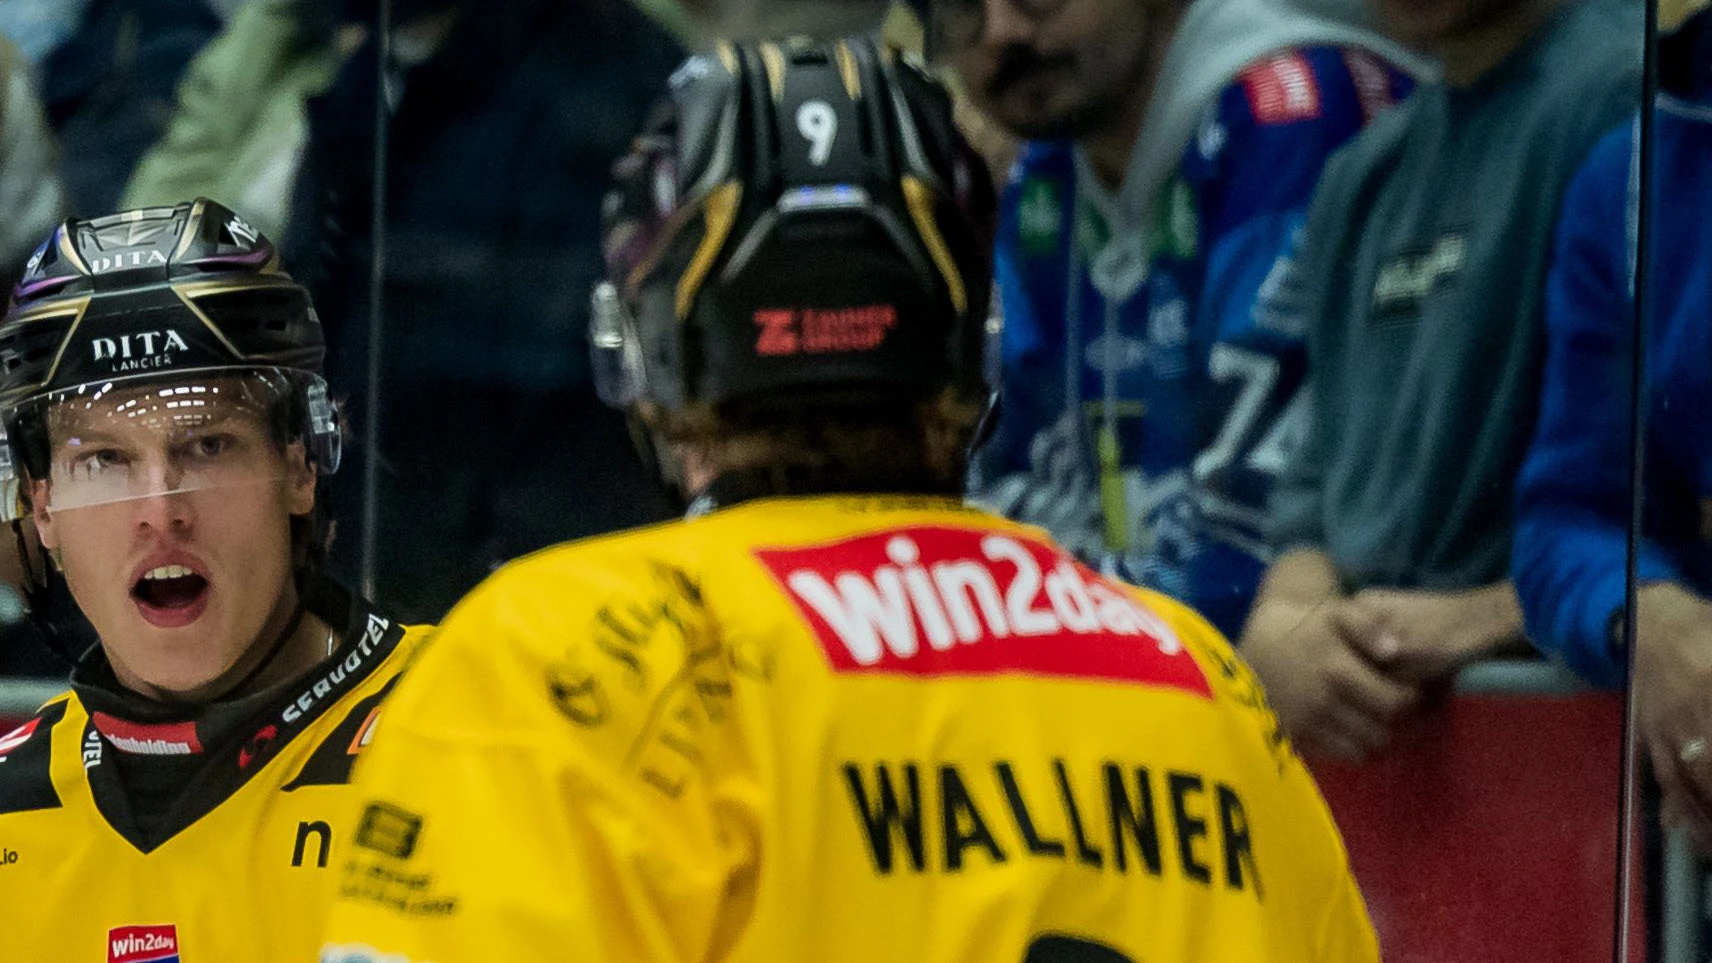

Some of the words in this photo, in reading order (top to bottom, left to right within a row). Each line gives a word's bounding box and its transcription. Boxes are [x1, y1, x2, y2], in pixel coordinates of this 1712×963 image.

[796, 99, 838, 166] 9
[92, 250, 168, 273] DITA
[92, 329, 188, 361] DITA
[112, 353, 172, 372] LANCIER
[787, 535, 1184, 666] win2day
[282, 613, 389, 722] SERVOTEL
[843, 760, 1263, 901] WALLNER
[112, 933, 175, 958] win2day
